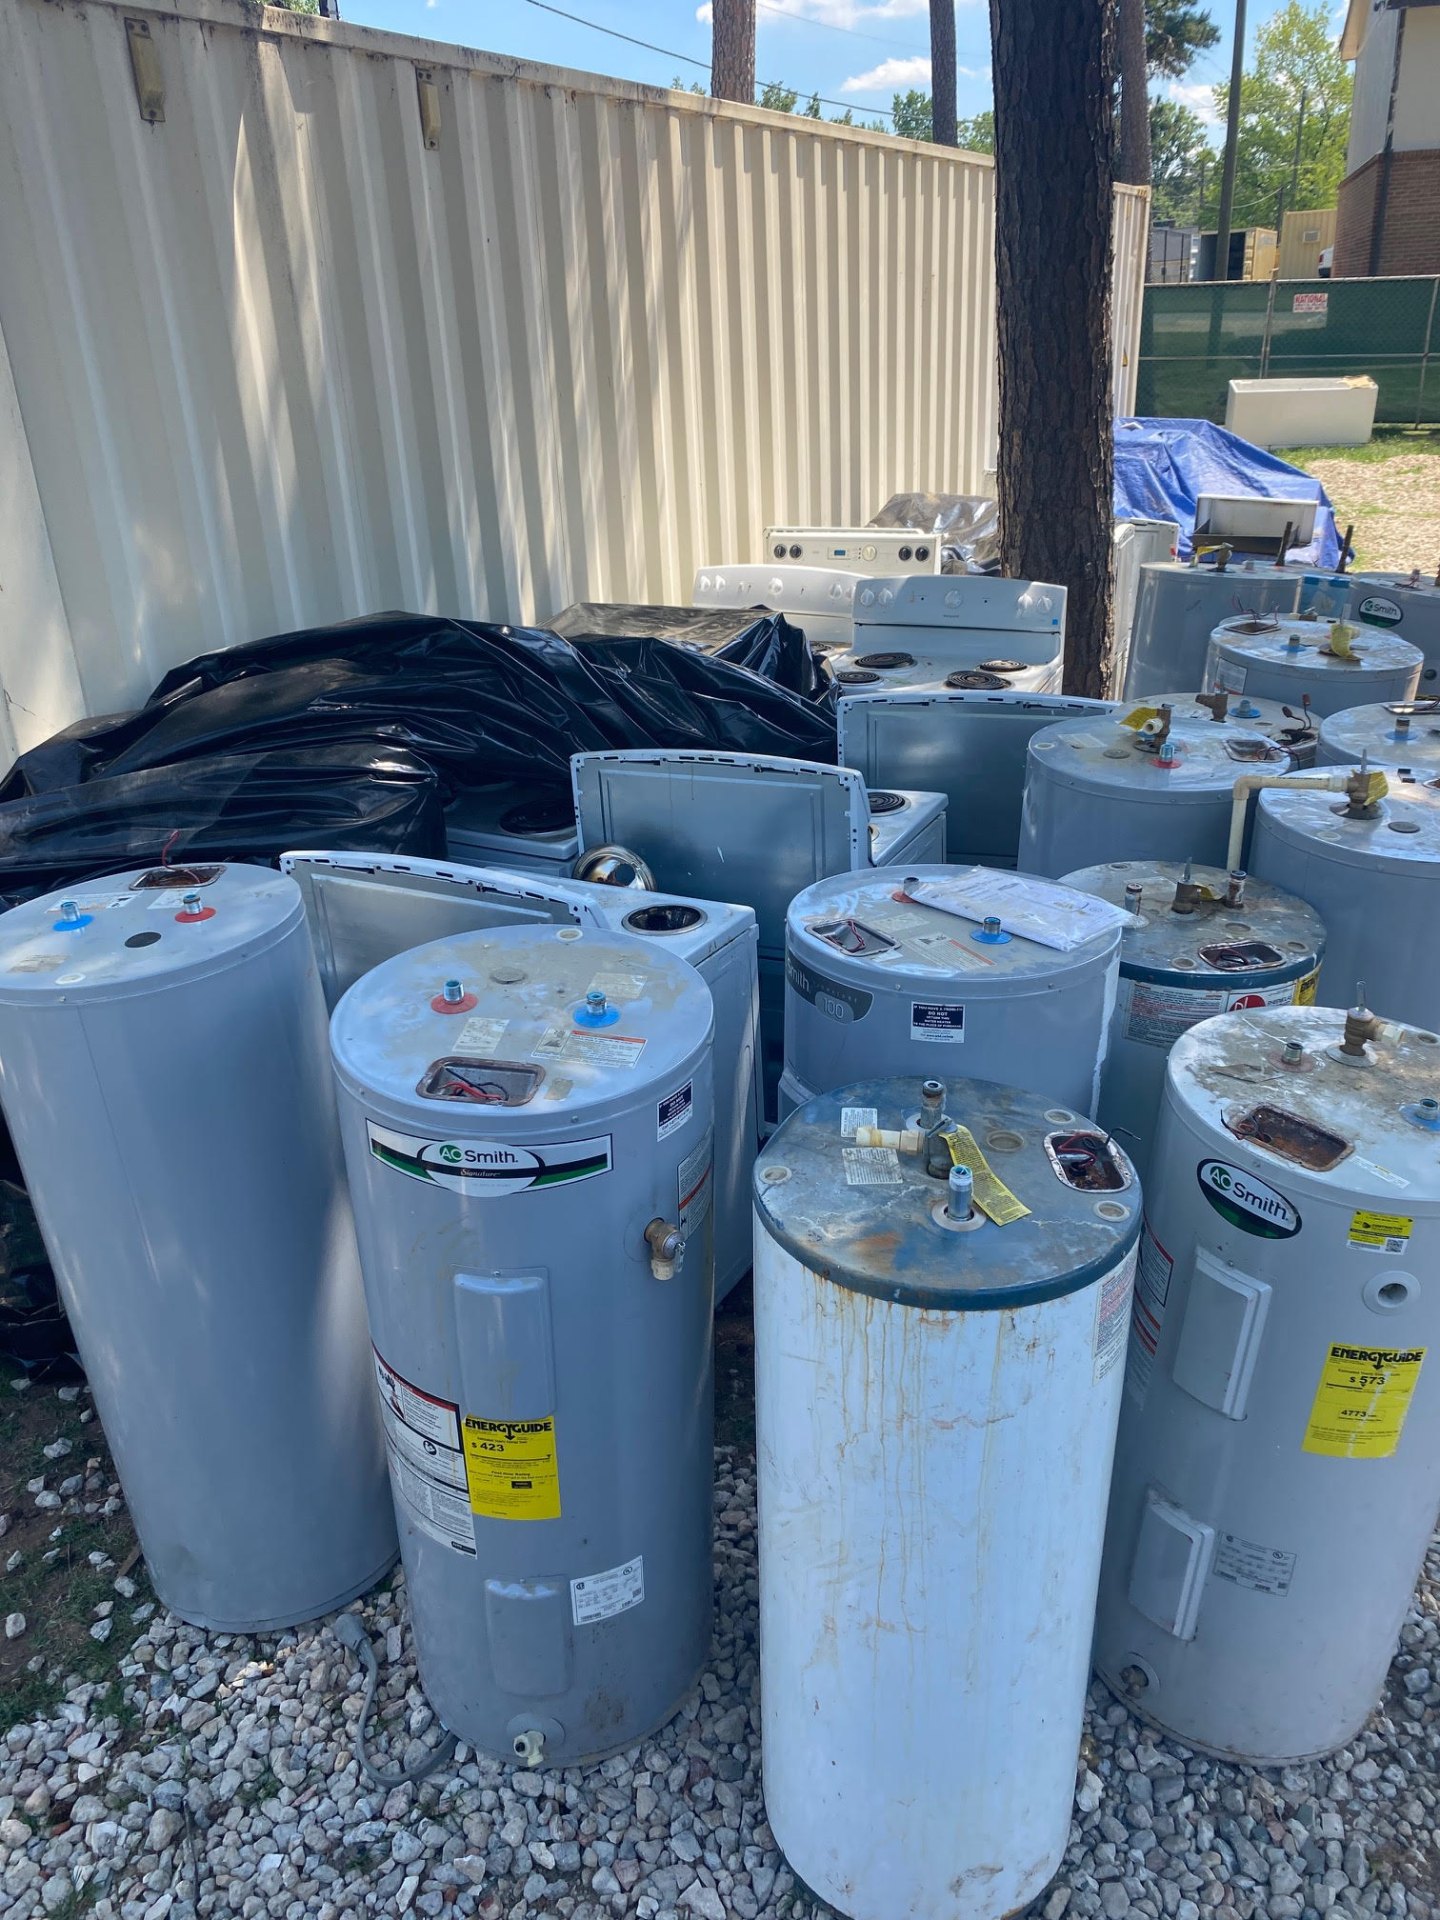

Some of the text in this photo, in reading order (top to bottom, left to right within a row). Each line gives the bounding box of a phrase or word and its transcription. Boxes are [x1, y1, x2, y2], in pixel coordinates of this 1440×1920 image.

[822, 997, 844, 1019] 100
[1331, 1347, 1423, 1363] ENERGYGUIDE
[1359, 1376, 1385, 1385] 573
[465, 1418, 552, 1433] ENERGYGUIDE
[480, 1443, 504, 1452] 423
